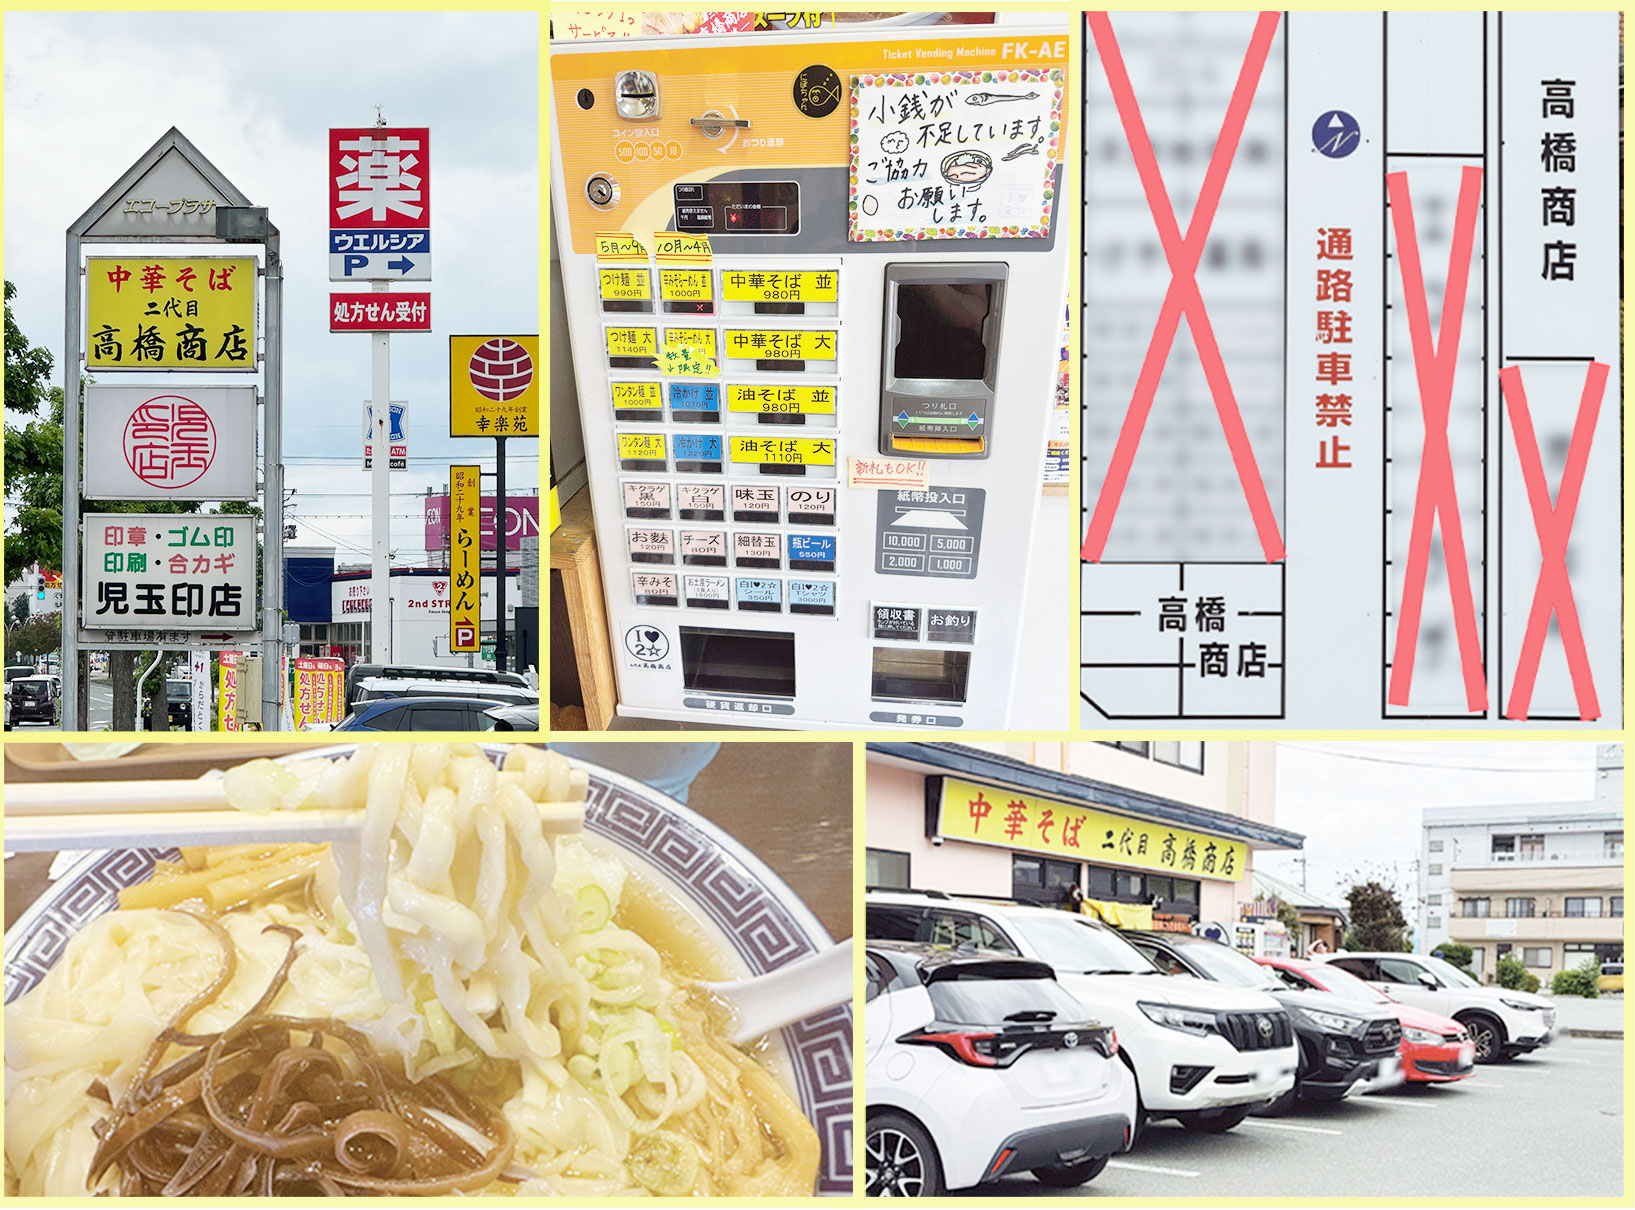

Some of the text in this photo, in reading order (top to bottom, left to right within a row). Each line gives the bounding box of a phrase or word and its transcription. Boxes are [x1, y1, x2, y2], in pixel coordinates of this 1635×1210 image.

[882, 41, 1067, 60] Ticket Vending Machine FK-AE
[867, 89, 958, 124] 小銭が
[612, 128, 660, 139] コイン投入口
[916, 115, 1044, 149] 不足しています。
[742, 137, 784, 148] おつり返却
[618, 146, 677, 157] 500 100 50 10
[866, 156, 928, 183] ご協力
[336, 136, 423, 221] 薬
[1540, 78, 1577, 281] 高橋商店
[897, 185, 966, 210] お願い
[932, 198, 987, 224] します。
[334, 233, 424, 251] ウエルシア
[344, 255, 369, 276] P
[107, 264, 236, 294] 中華そば
[602, 273, 645, 287] つけ麺 並
[730, 273, 832, 290] 中華そば 並
[613, 289, 642, 297] 990円
[669, 290, 701, 298] 1000円
[763, 290, 800, 300] 980円
[144, 297, 198, 318] 二代目
[334, 301, 427, 323] 処方せん受付
[92, 323, 249, 362] 高橋商店
[610, 331, 652, 344] つけ麺 大
[733, 333, 831, 350] 中華そば 大
[617, 345, 647, 354] 1140円
[764, 349, 801, 359] 980円
[1315, 228, 1353, 468] 通路駐車禁止
[614, 385, 657, 398] ワンタン麺 並
[672, 387, 714, 401] 冷かけ 並
[737, 388, 830, 403] 油そば 並
[623, 398, 652, 406] 1000円
[762, 403, 800, 413] 980円
[922, 402, 957, 410] つり札口
[475, 414, 528, 432] 幸楽苑
[621, 436, 662, 449] ワンタン麺 大
[677, 436, 717, 450] 冷かけ 大
[740, 439, 831, 454] 油そば 大
[628, 449, 657, 457] 1120円
[682, 449, 713, 458] 1220円
[764, 453, 802, 463] 1110円
[627, 484, 666, 493] キクラゲ
[682, 486, 720, 496] キクラゲ
[638, 492, 654, 501] 黒
[691, 494, 709, 503] 白
[735, 489, 775, 502] 味玉
[790, 490, 830, 504] のり
[896, 490, 965, 504] 紙幣投入口
[798, 503, 825, 511] 120円
[683, 534, 720, 546] チーズ
[737, 536, 776, 548] 細替玉
[792, 537, 831, 549] 瓶ビール
[888, 535, 966, 550] 10,000 5,000
[745, 549, 771, 557] 130円
[798, 551, 826, 559] 550円
[455, 528, 475, 611] らーめん
[889, 556, 962, 570] 2,000 1,000
[637, 576, 673, 588] 辛みそ
[687, 578, 725, 587] お土産ラーメン
[95, 581, 242, 617] 児玉印店
[408, 599, 428, 608] 2nd
[747, 594, 773, 602] 350円
[876, 608, 915, 621] 領収書
[930, 614, 971, 627] お釣り
[1158, 596, 1226, 632] 高橋
[458, 629, 473, 646] P
[1198, 641, 1267, 678] 商店
[705, 700, 772, 713] 硬貨返却口
[896, 713, 936, 725] 発券口
[968, 791, 1236, 876] 中華そば 二代目 高橋商店
